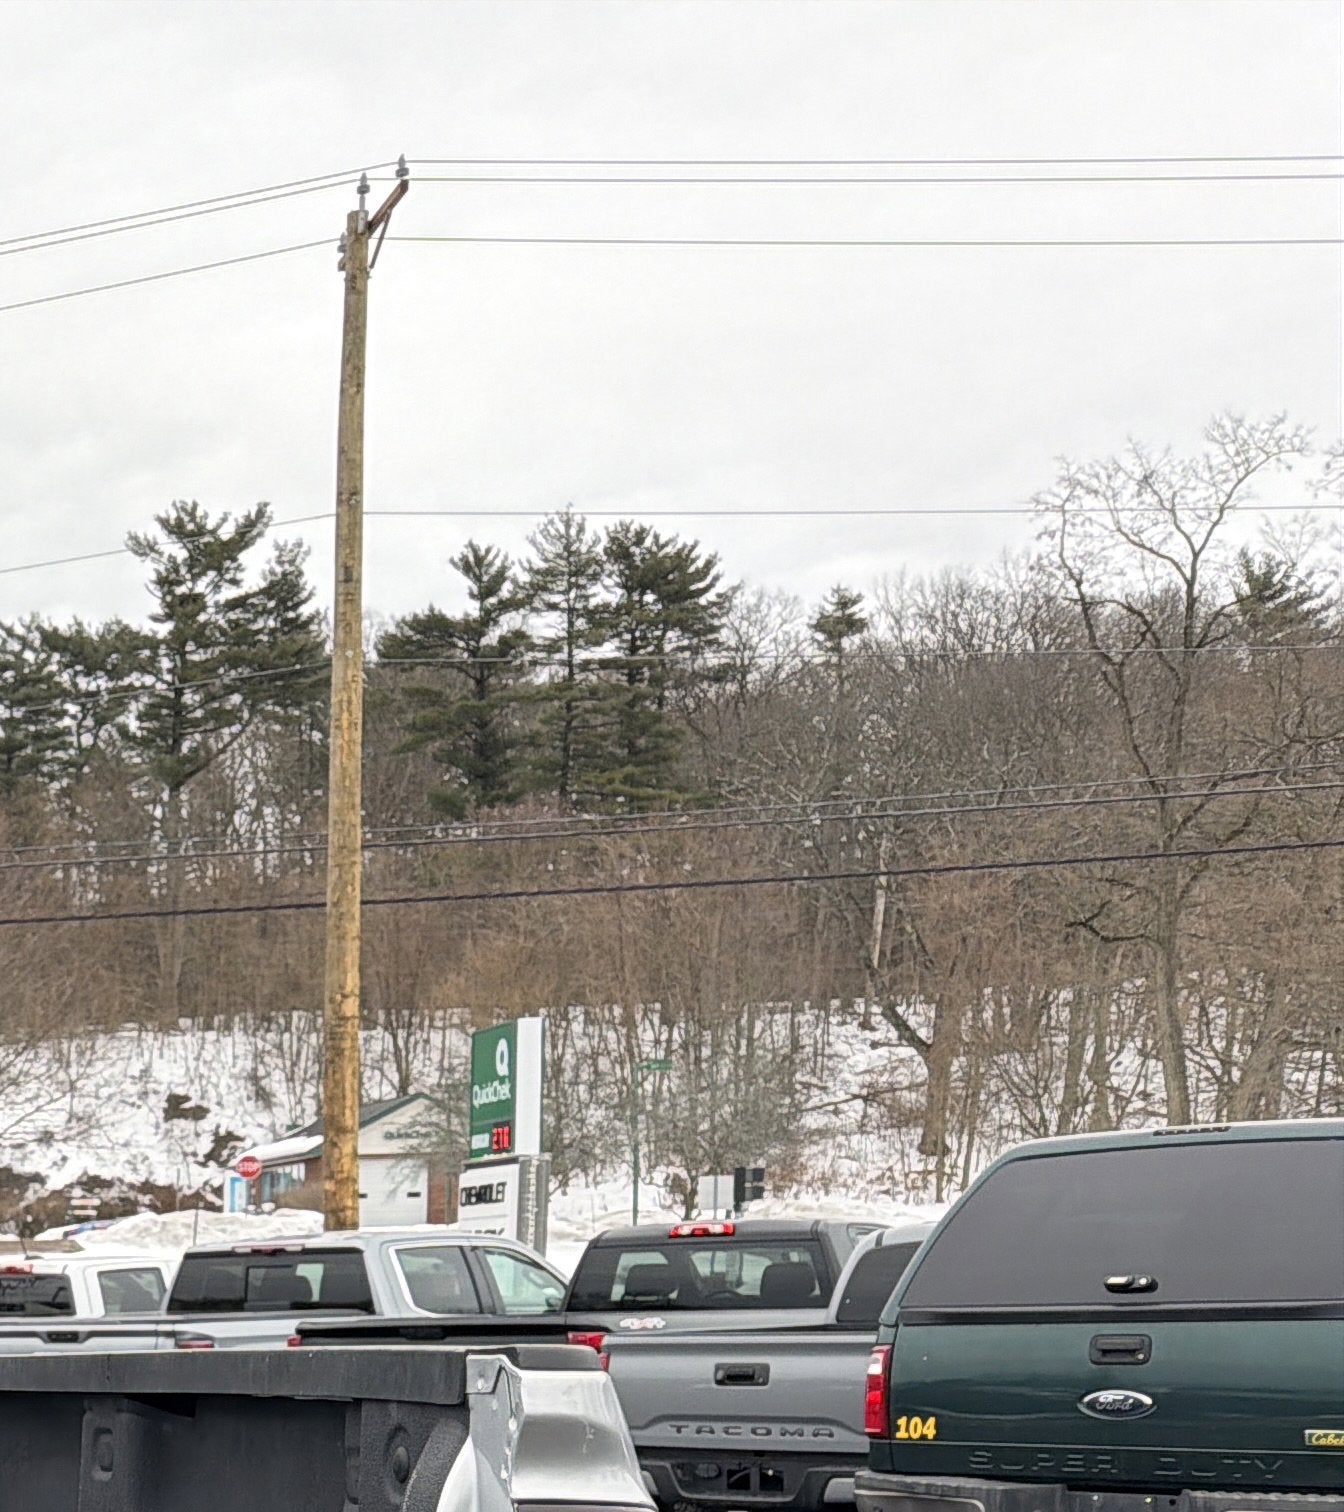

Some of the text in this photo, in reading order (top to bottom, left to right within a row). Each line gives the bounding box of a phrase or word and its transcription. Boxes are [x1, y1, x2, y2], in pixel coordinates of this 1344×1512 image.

[1096, 1394, 1134, 1410] Ford
[668, 1424, 835, 1438] TACOMA
[896, 1416, 937, 1440] 104
[968, 1451, 1284, 1479] SUPER DUTY
